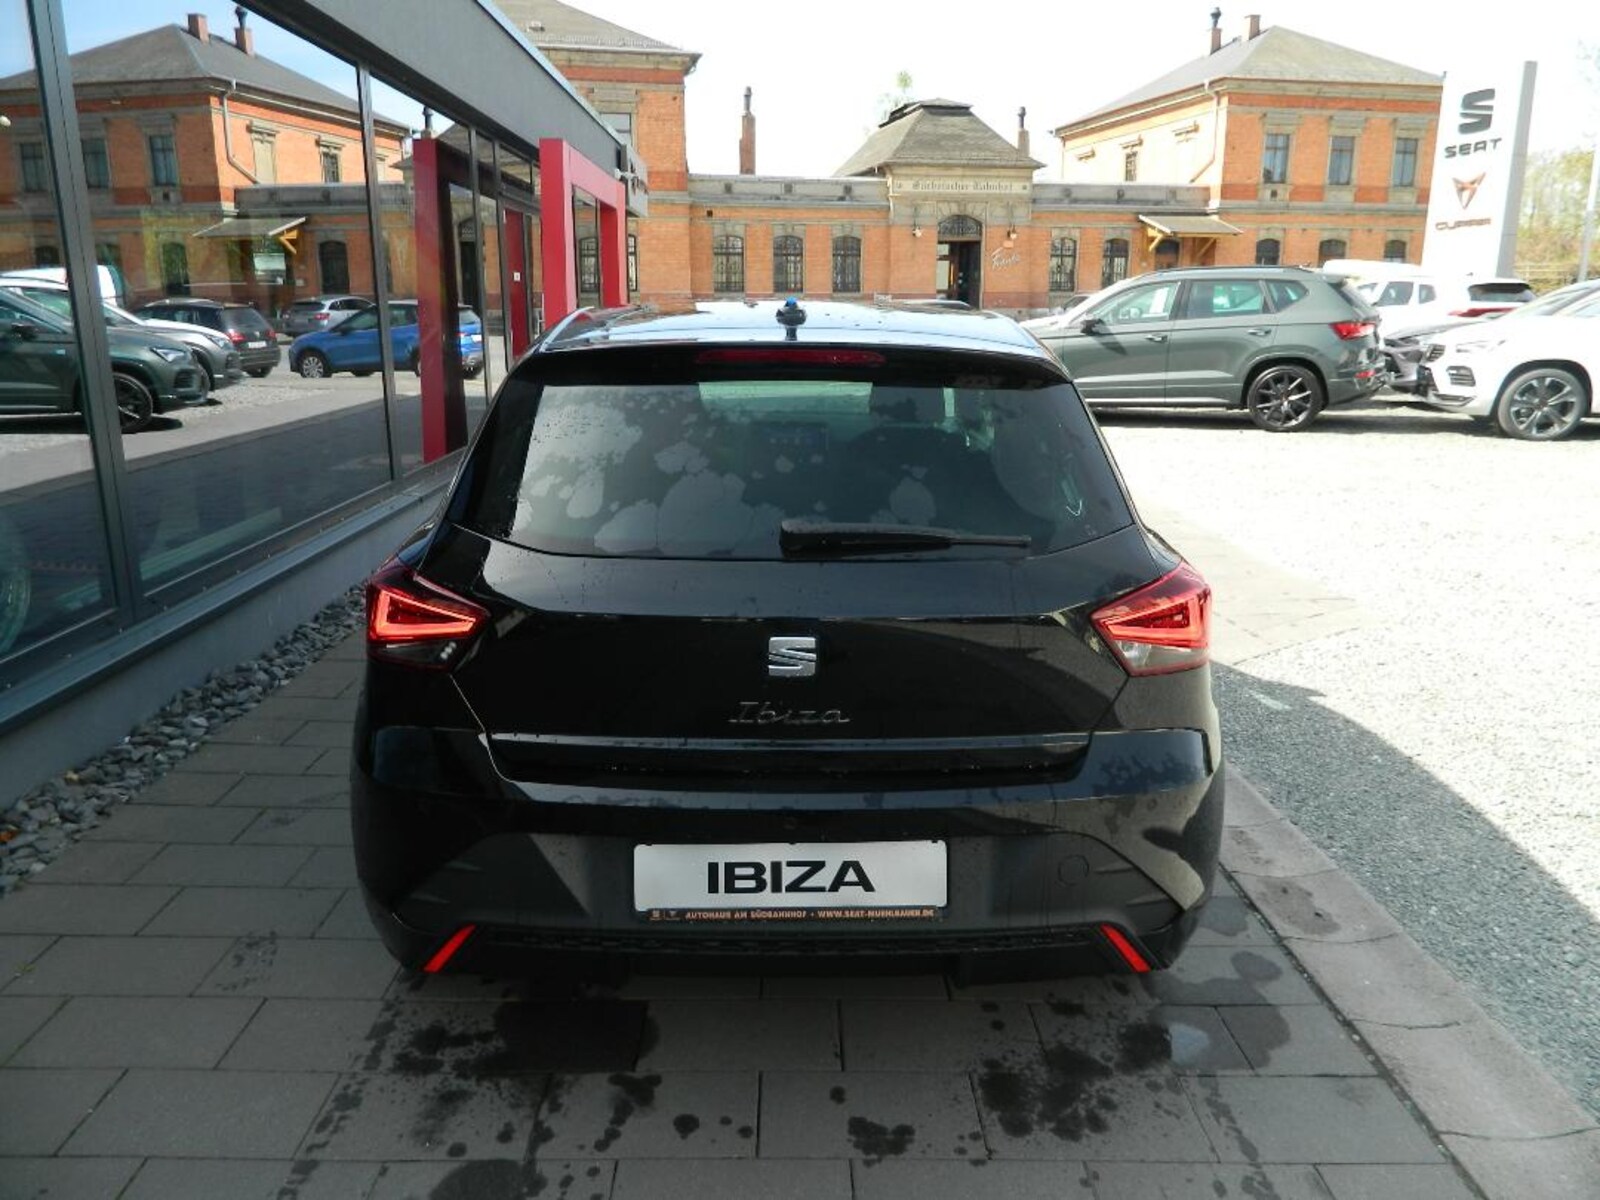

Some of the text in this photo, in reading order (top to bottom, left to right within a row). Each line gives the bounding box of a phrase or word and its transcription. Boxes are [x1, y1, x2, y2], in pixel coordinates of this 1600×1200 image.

[1444, 137, 1502, 159] SEAT
[728, 700, 850, 724] Ibiza
[707, 860, 876, 894] IBIZA
[685, 911, 731, 920] AUTOHAUS
[734, 911, 748, 919] AM
